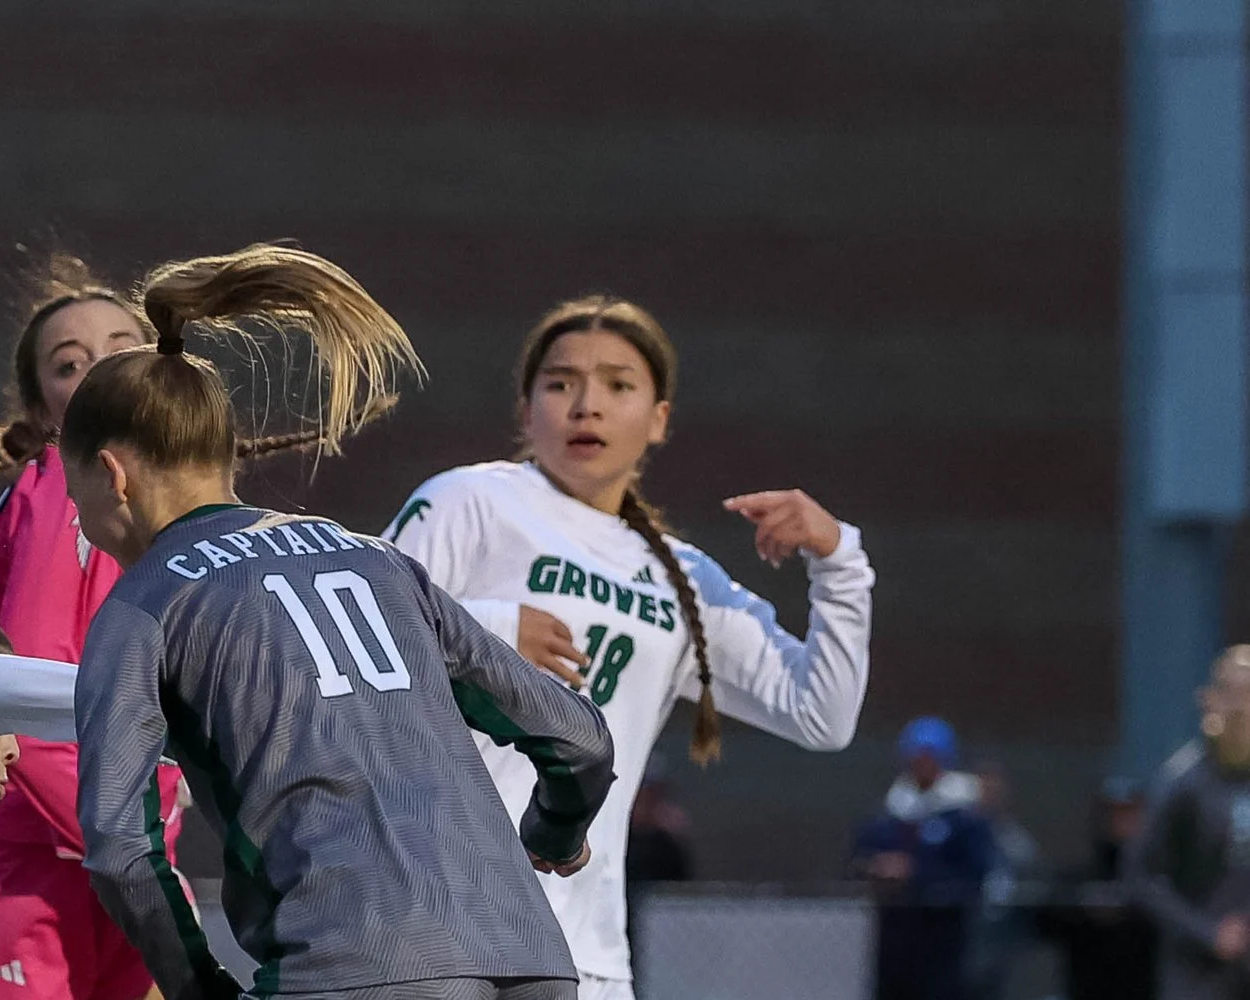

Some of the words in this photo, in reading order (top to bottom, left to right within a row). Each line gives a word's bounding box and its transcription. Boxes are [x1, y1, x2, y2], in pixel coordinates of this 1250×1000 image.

[262, 570, 411, 697] 10
[527, 555, 675, 632] GROVES
[570, 624, 634, 707] 18
